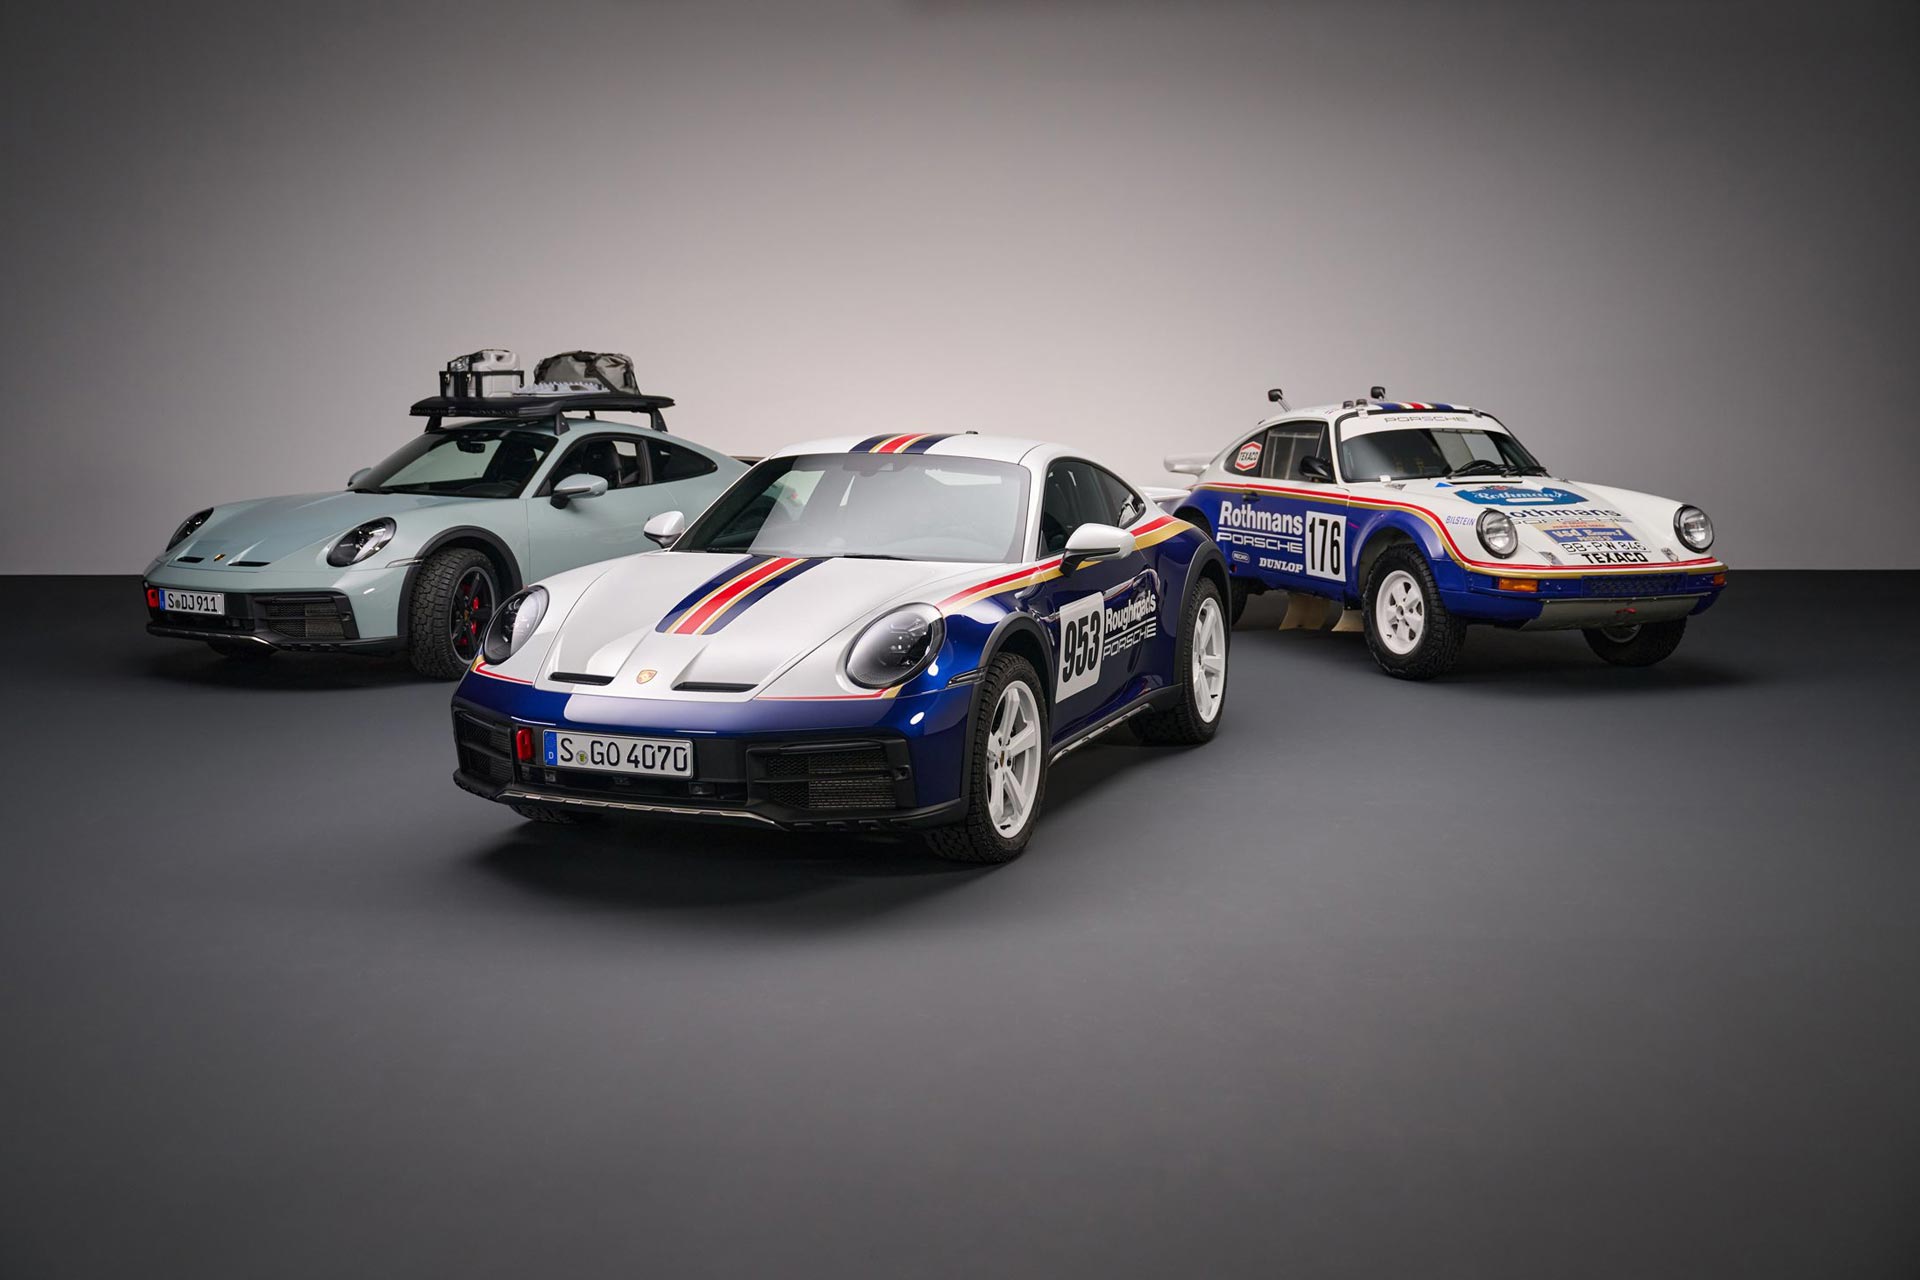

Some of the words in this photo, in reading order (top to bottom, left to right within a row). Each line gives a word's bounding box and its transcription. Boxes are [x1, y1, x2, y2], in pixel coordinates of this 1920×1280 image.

[1218, 500, 1303, 535] Rothmans
[1446, 515, 1475, 526] BILSTEIN
[1506, 509, 1622, 518] othmans
[1216, 532, 1303, 554] PORSCHE
[1309, 517, 1341, 576] 176
[1259, 557, 1303, 574] DUNLOP
[1581, 552, 1649, 564] TEXACO
[168, 593, 174, 608] S
[181, 595, 195, 610] DJ
[197, 596, 217, 612] 911
[1105, 590, 1157, 633] Roughroads
[1062, 610, 1101, 683] 953
[1103, 622, 1157, 660] PORSCHE
[560, 738, 574, 762] S
[590, 740, 620, 766] GO
[626, 743, 688, 772] 4070
